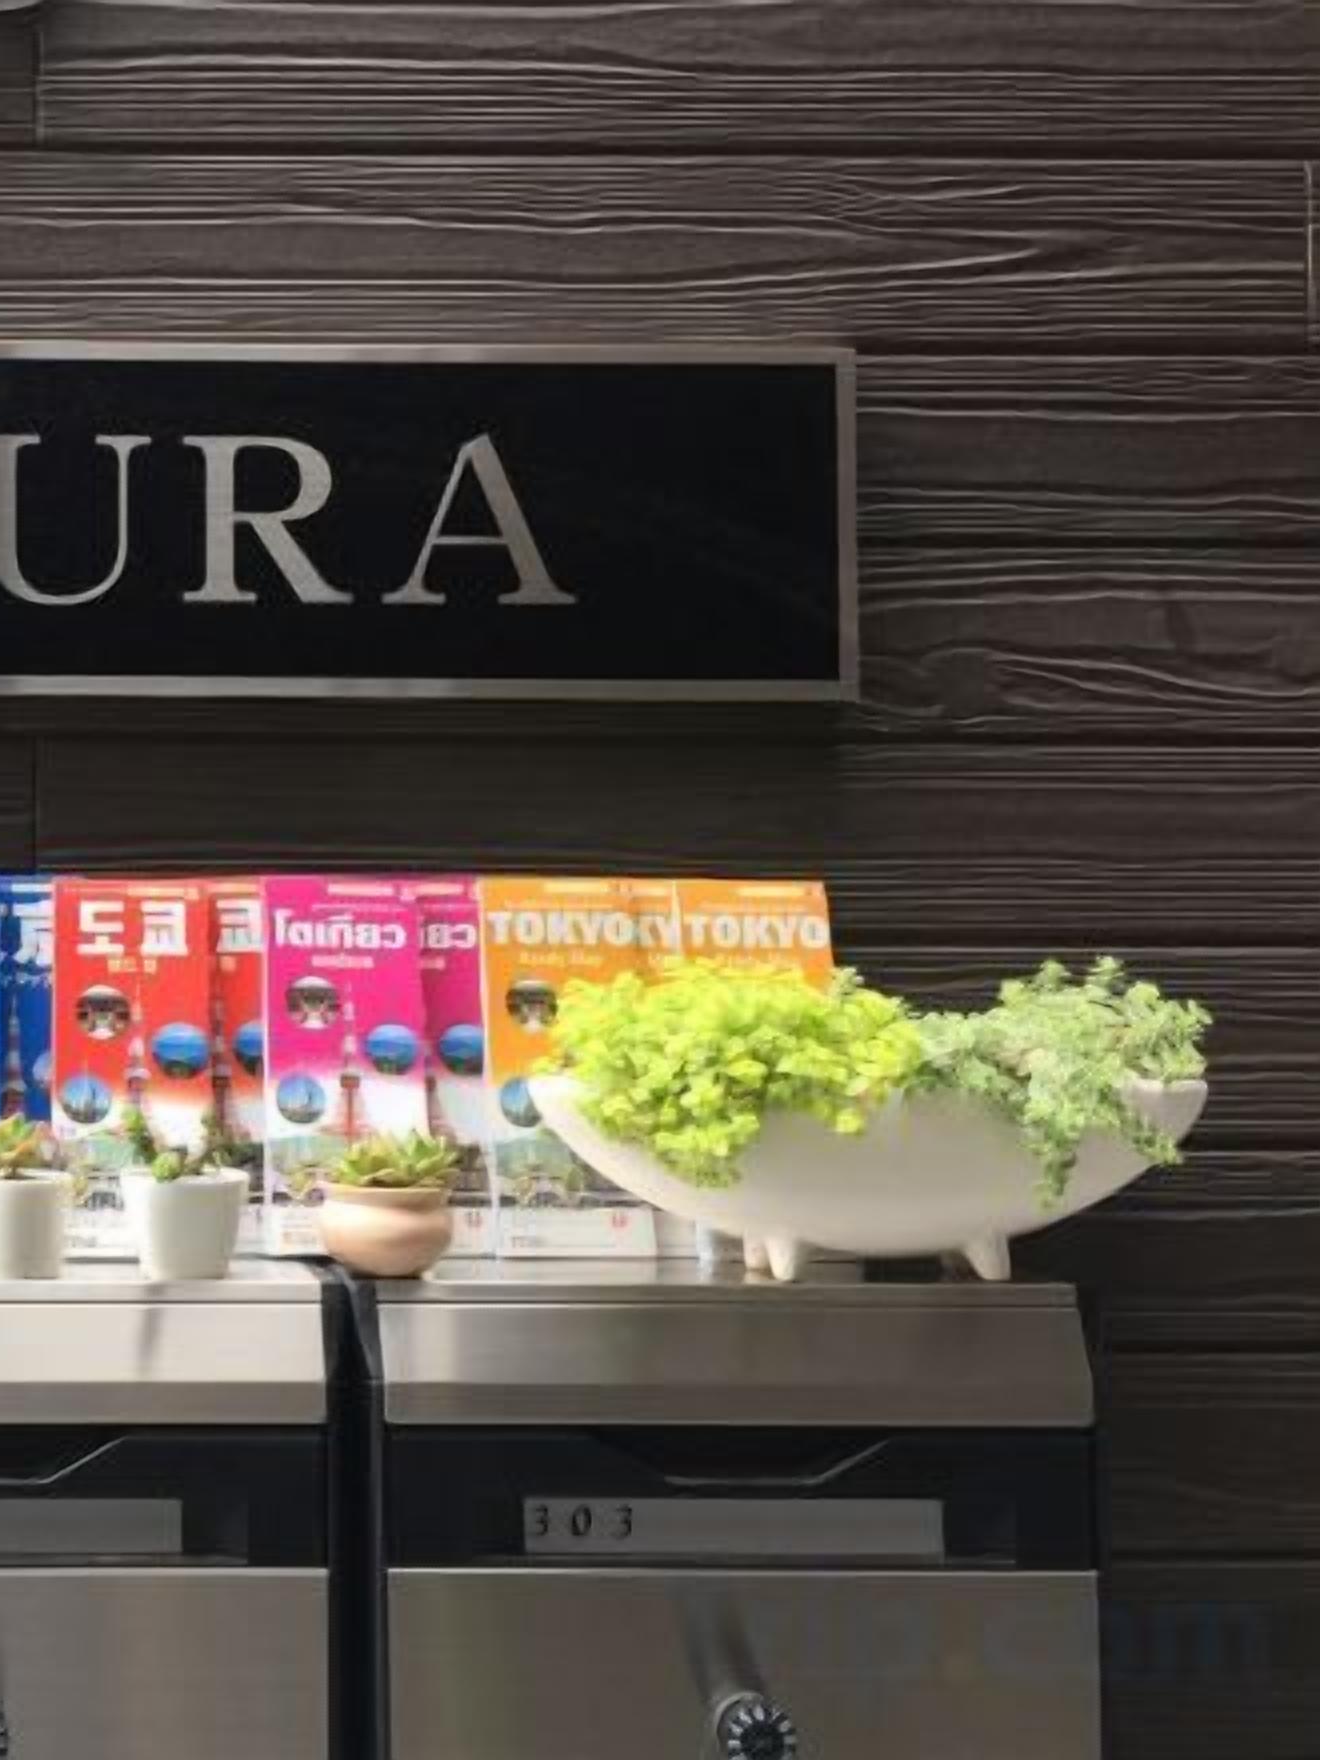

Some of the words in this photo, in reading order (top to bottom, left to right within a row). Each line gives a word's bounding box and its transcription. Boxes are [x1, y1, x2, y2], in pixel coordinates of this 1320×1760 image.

[76, 899, 189, 957] 도쿄
[486, 910, 633, 945] TOKYO
[686, 913, 829, 948] TOKYO
[530, 1503, 635, 1540] 303
